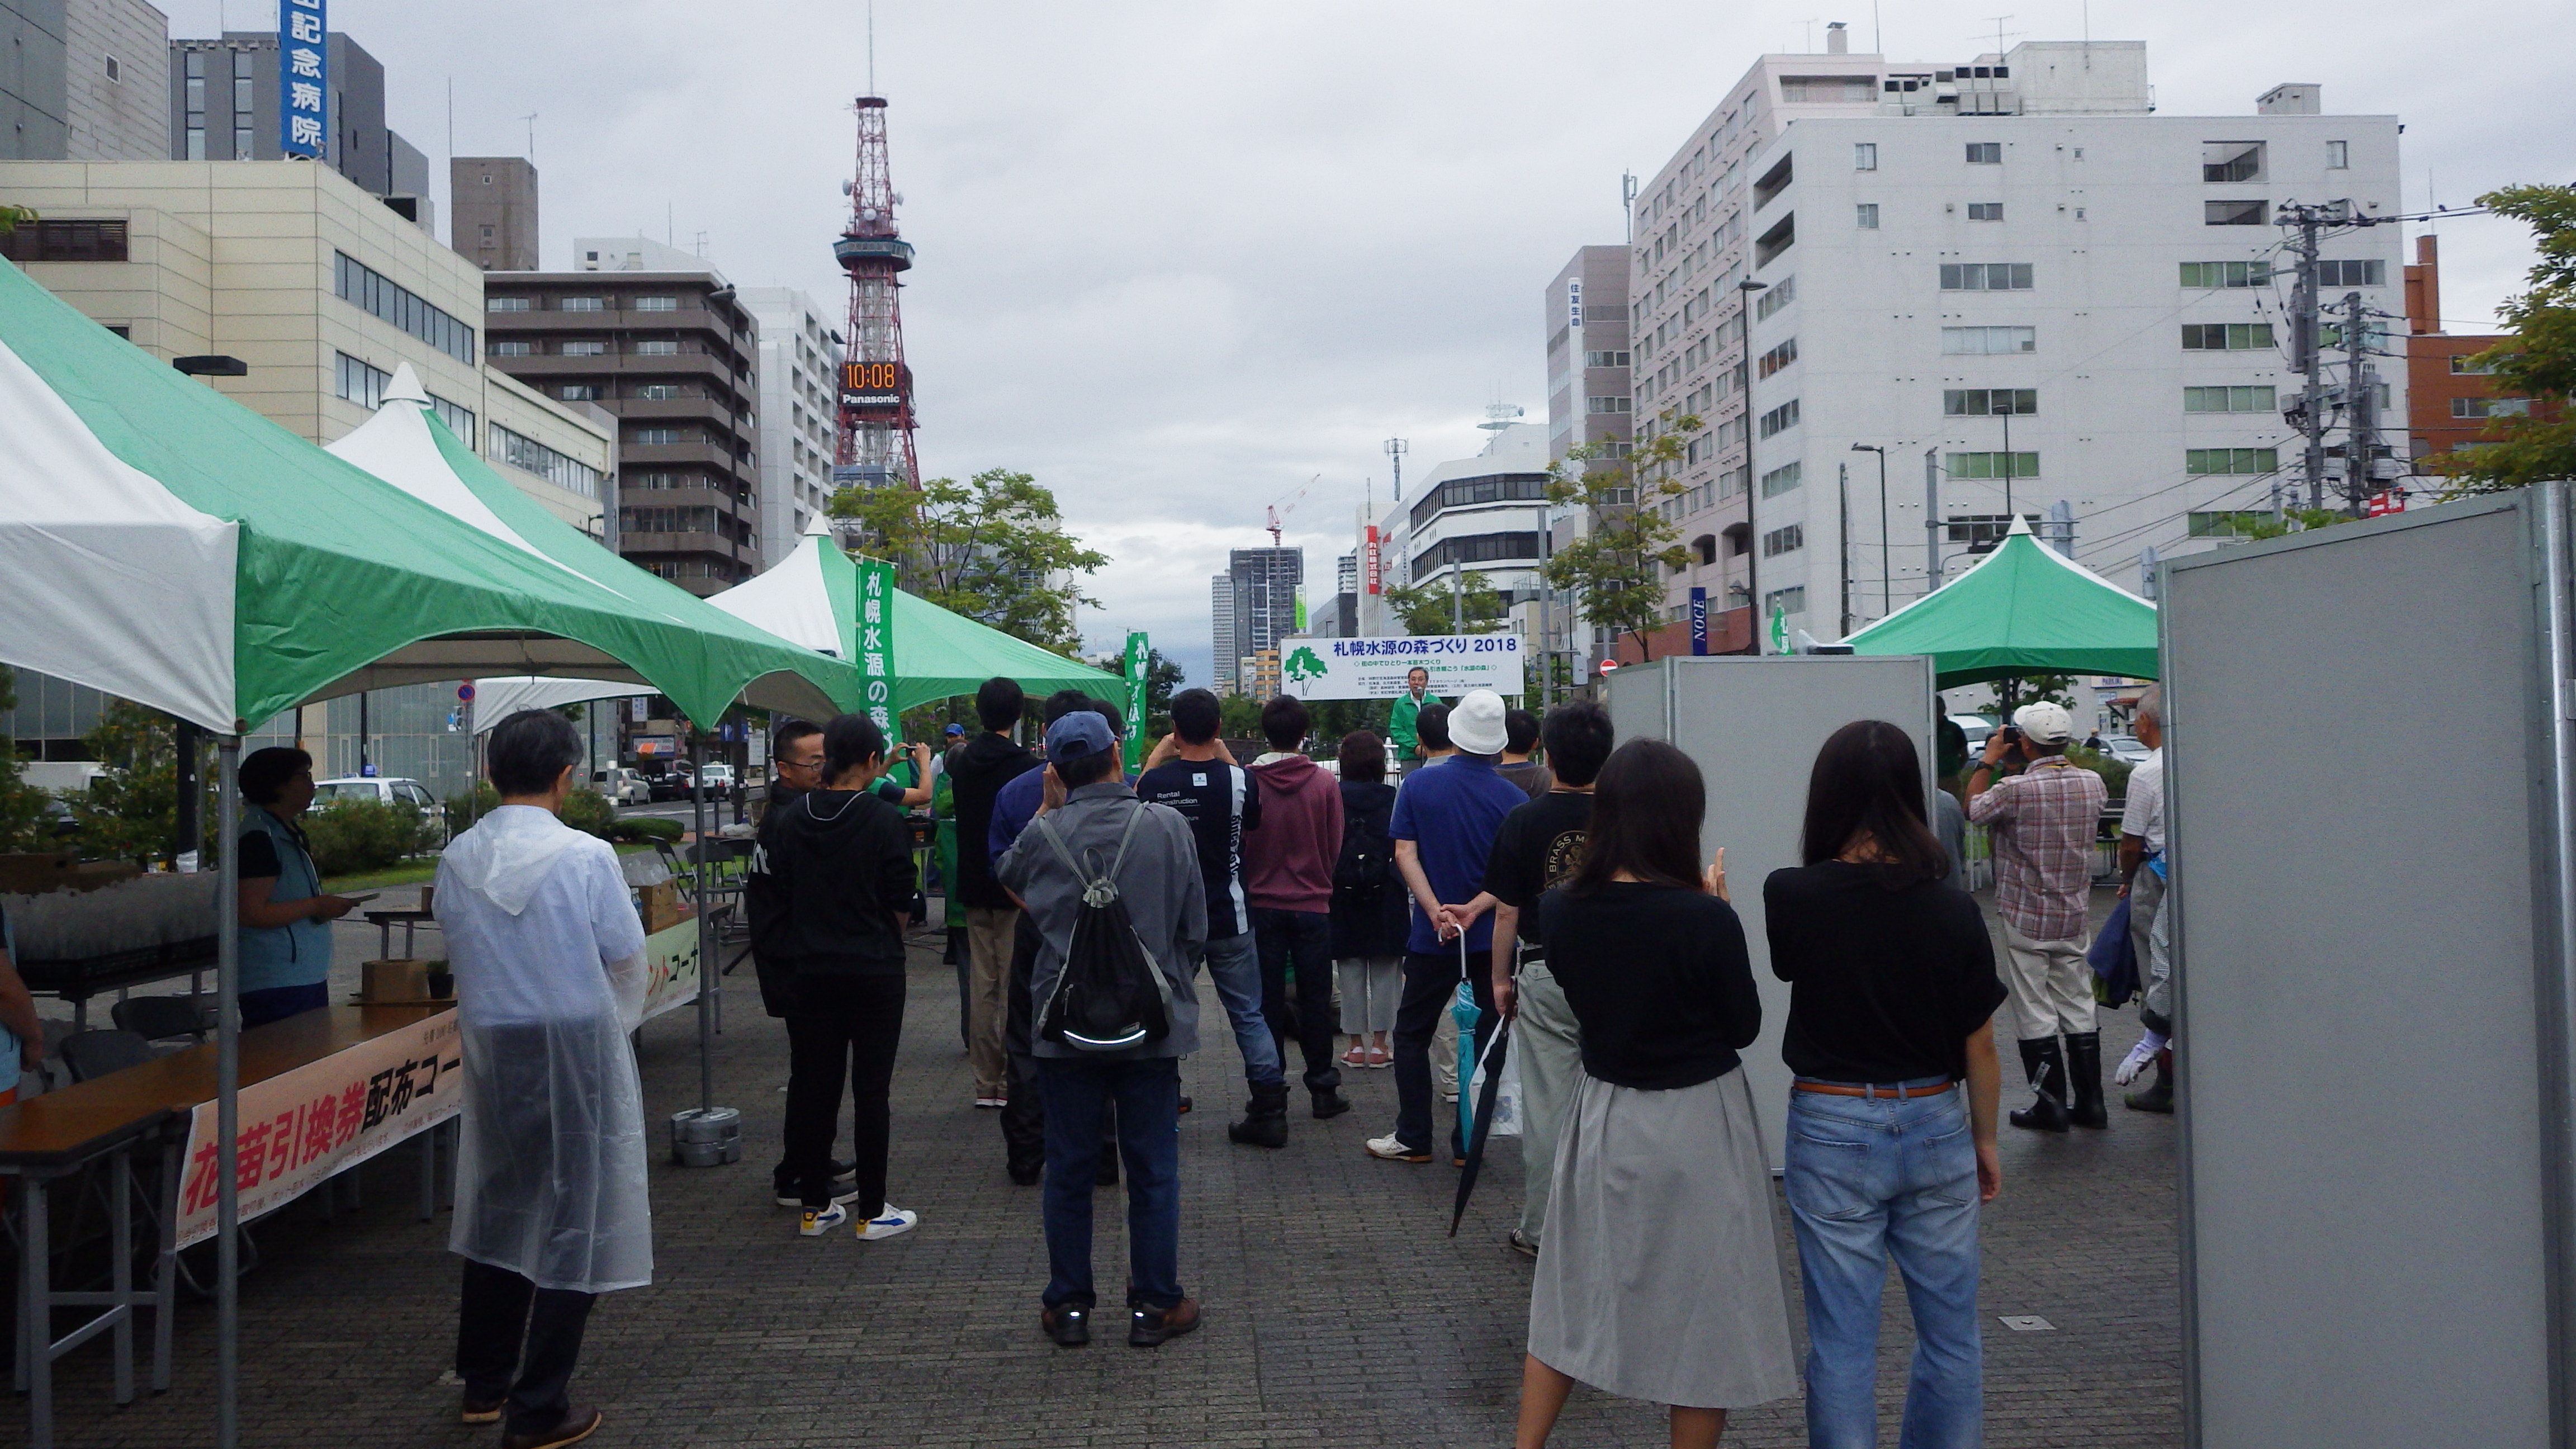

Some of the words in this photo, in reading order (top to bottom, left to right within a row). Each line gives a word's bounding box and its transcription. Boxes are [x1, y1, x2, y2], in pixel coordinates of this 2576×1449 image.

[1570, 283, 1580, 326] 住友生命
[847, 364, 895, 388] 10:08
[842, 394, 900, 404] Panasonic
[1693, 599, 1706, 642] NOCE
[1334, 638, 1467, 656] 札幌水源の森づくり
[1474, 638, 1517, 652] 2018
[1549, 836, 1571, 873] BRASS
